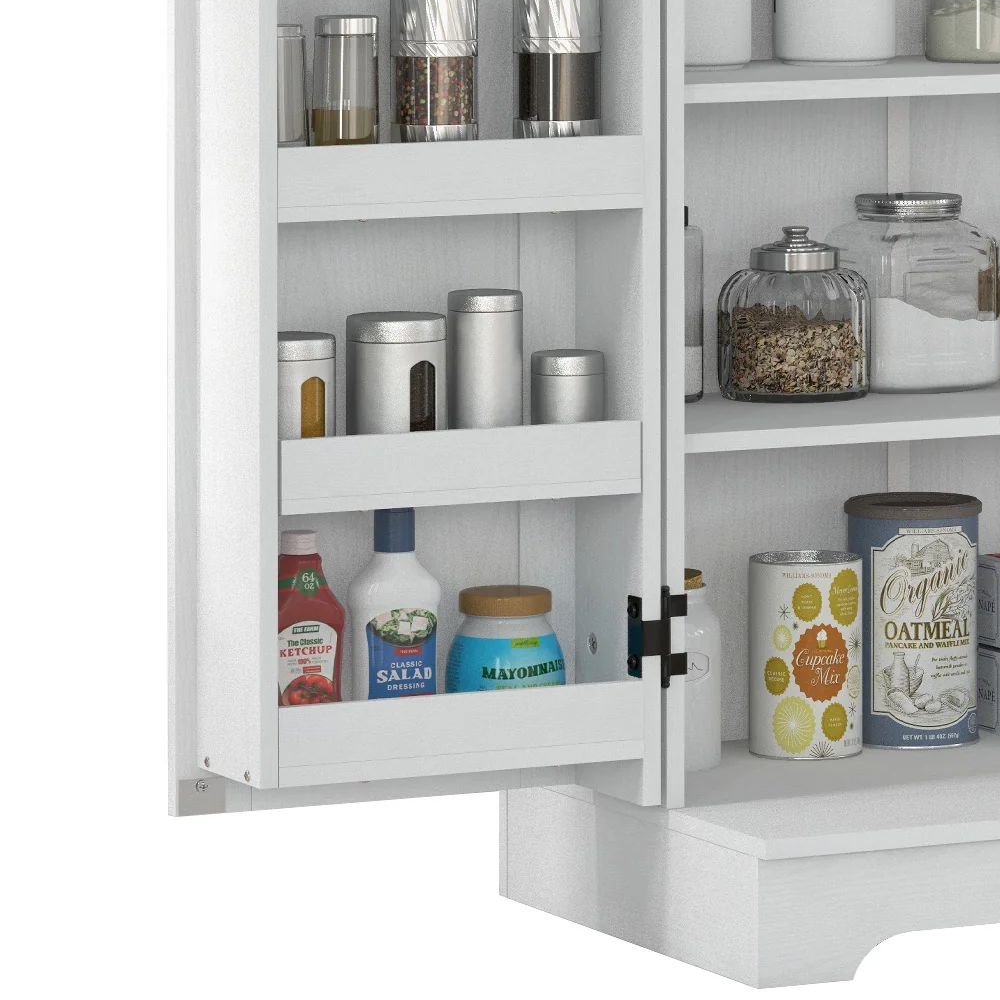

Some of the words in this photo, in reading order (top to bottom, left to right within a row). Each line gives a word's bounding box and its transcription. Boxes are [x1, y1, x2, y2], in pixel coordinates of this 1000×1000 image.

[302, 572, 315, 583] 64
[880, 549, 968, 618] Organic
[884, 618, 970, 641] OATMEAL
[287, 640, 300, 648] The
[300, 638, 324, 646] Classic
[884, 641, 917, 649] PANCAKE
[935, 640, 960, 648] WAFFLE
[959, 638, 970, 646] MIX
[279, 645, 333, 658] KETCHUP
[391, 660, 423, 669] CLASSIC
[795, 648, 845, 670] Cupcake
[376, 666, 433, 684] SALAD
[811, 666, 841, 687] Mix
[387, 682, 425, 691] DRESSING
[978, 688, 996, 702] NAPÉ
